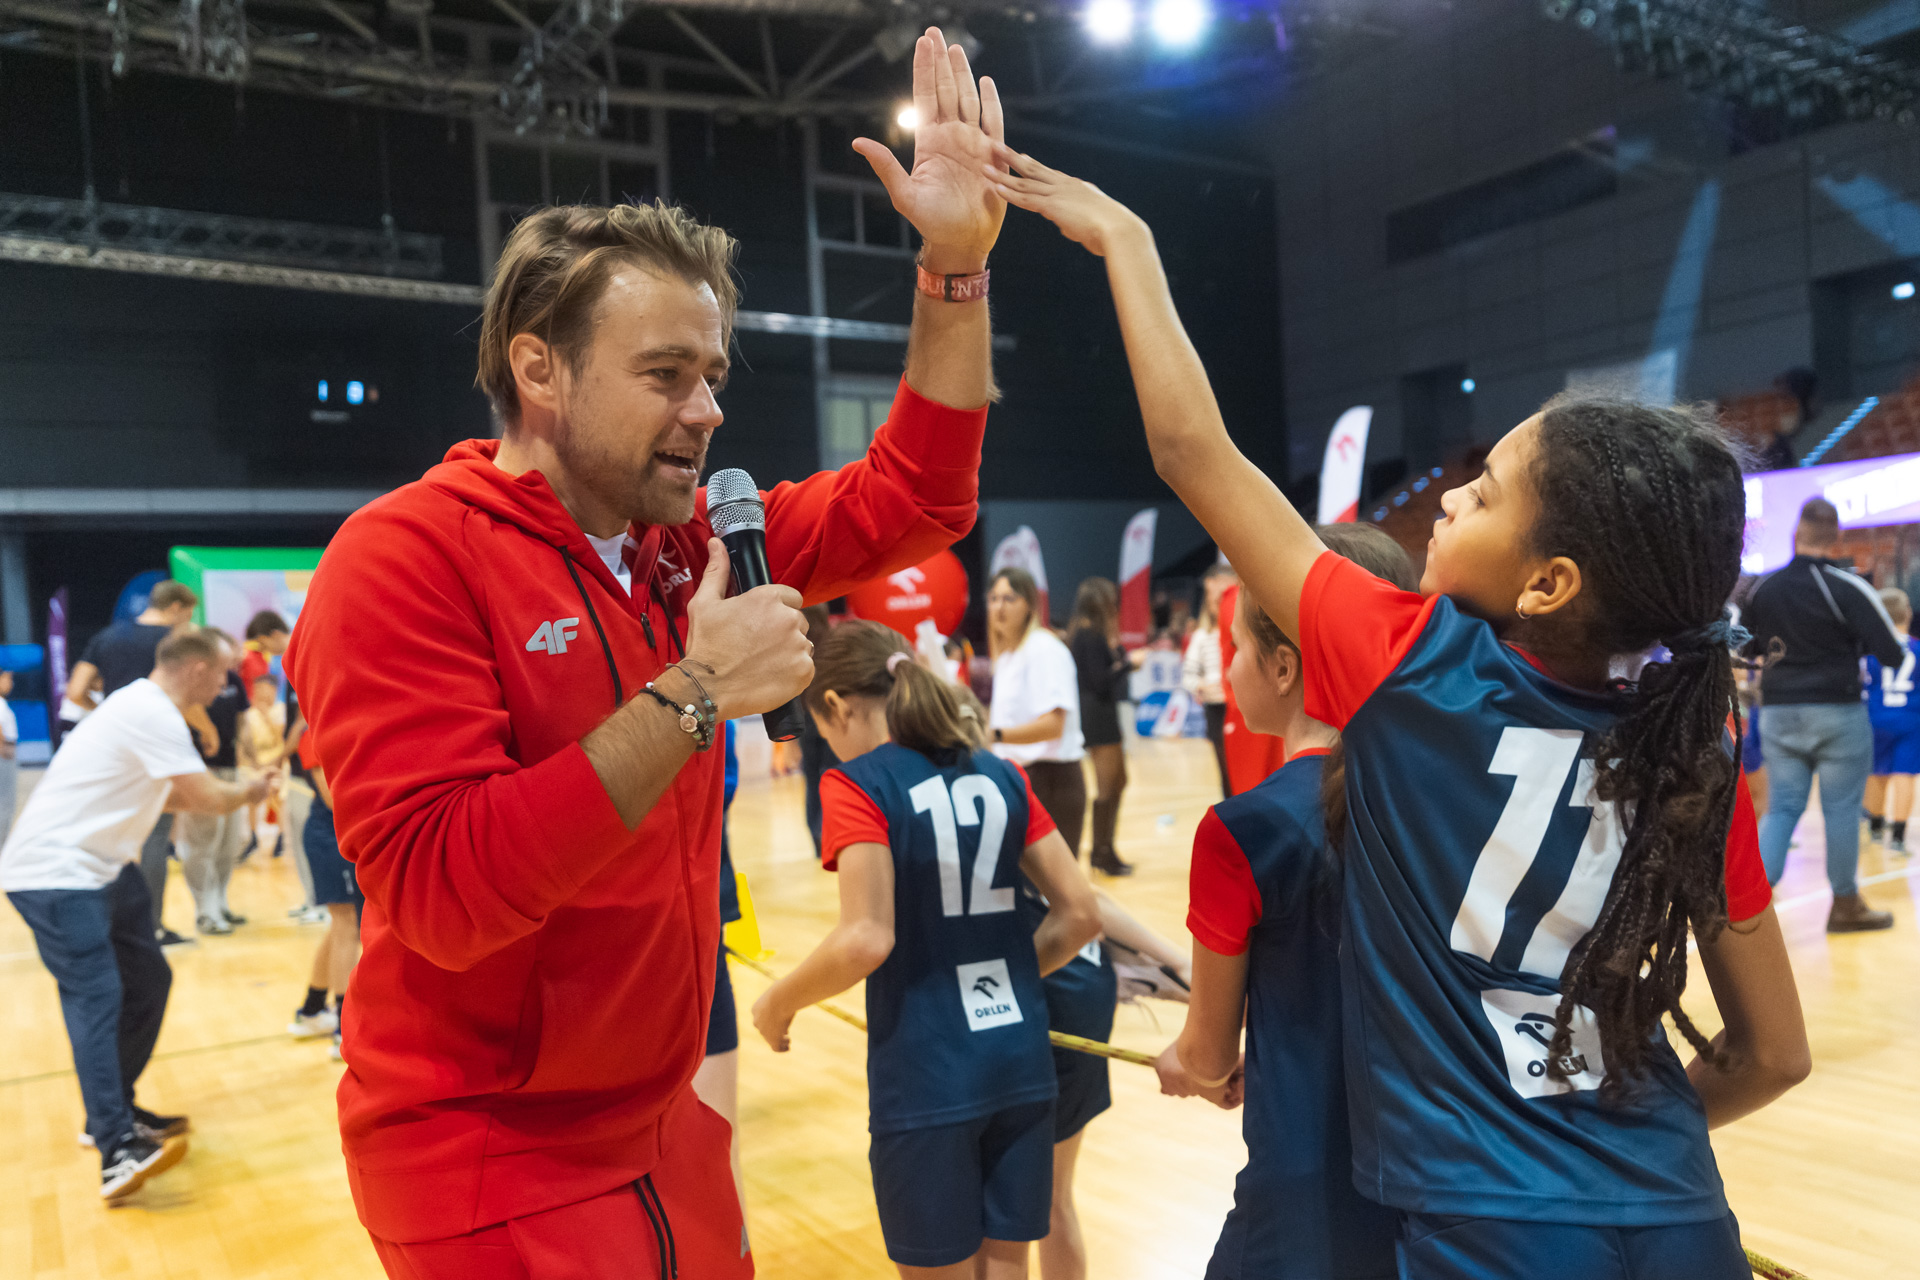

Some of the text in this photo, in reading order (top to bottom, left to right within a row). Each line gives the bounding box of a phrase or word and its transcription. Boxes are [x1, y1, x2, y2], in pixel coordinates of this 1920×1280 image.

[525, 617, 580, 655] 4F
[908, 773, 1016, 917] 12
[975, 1003, 1012, 1018] ORLEN
